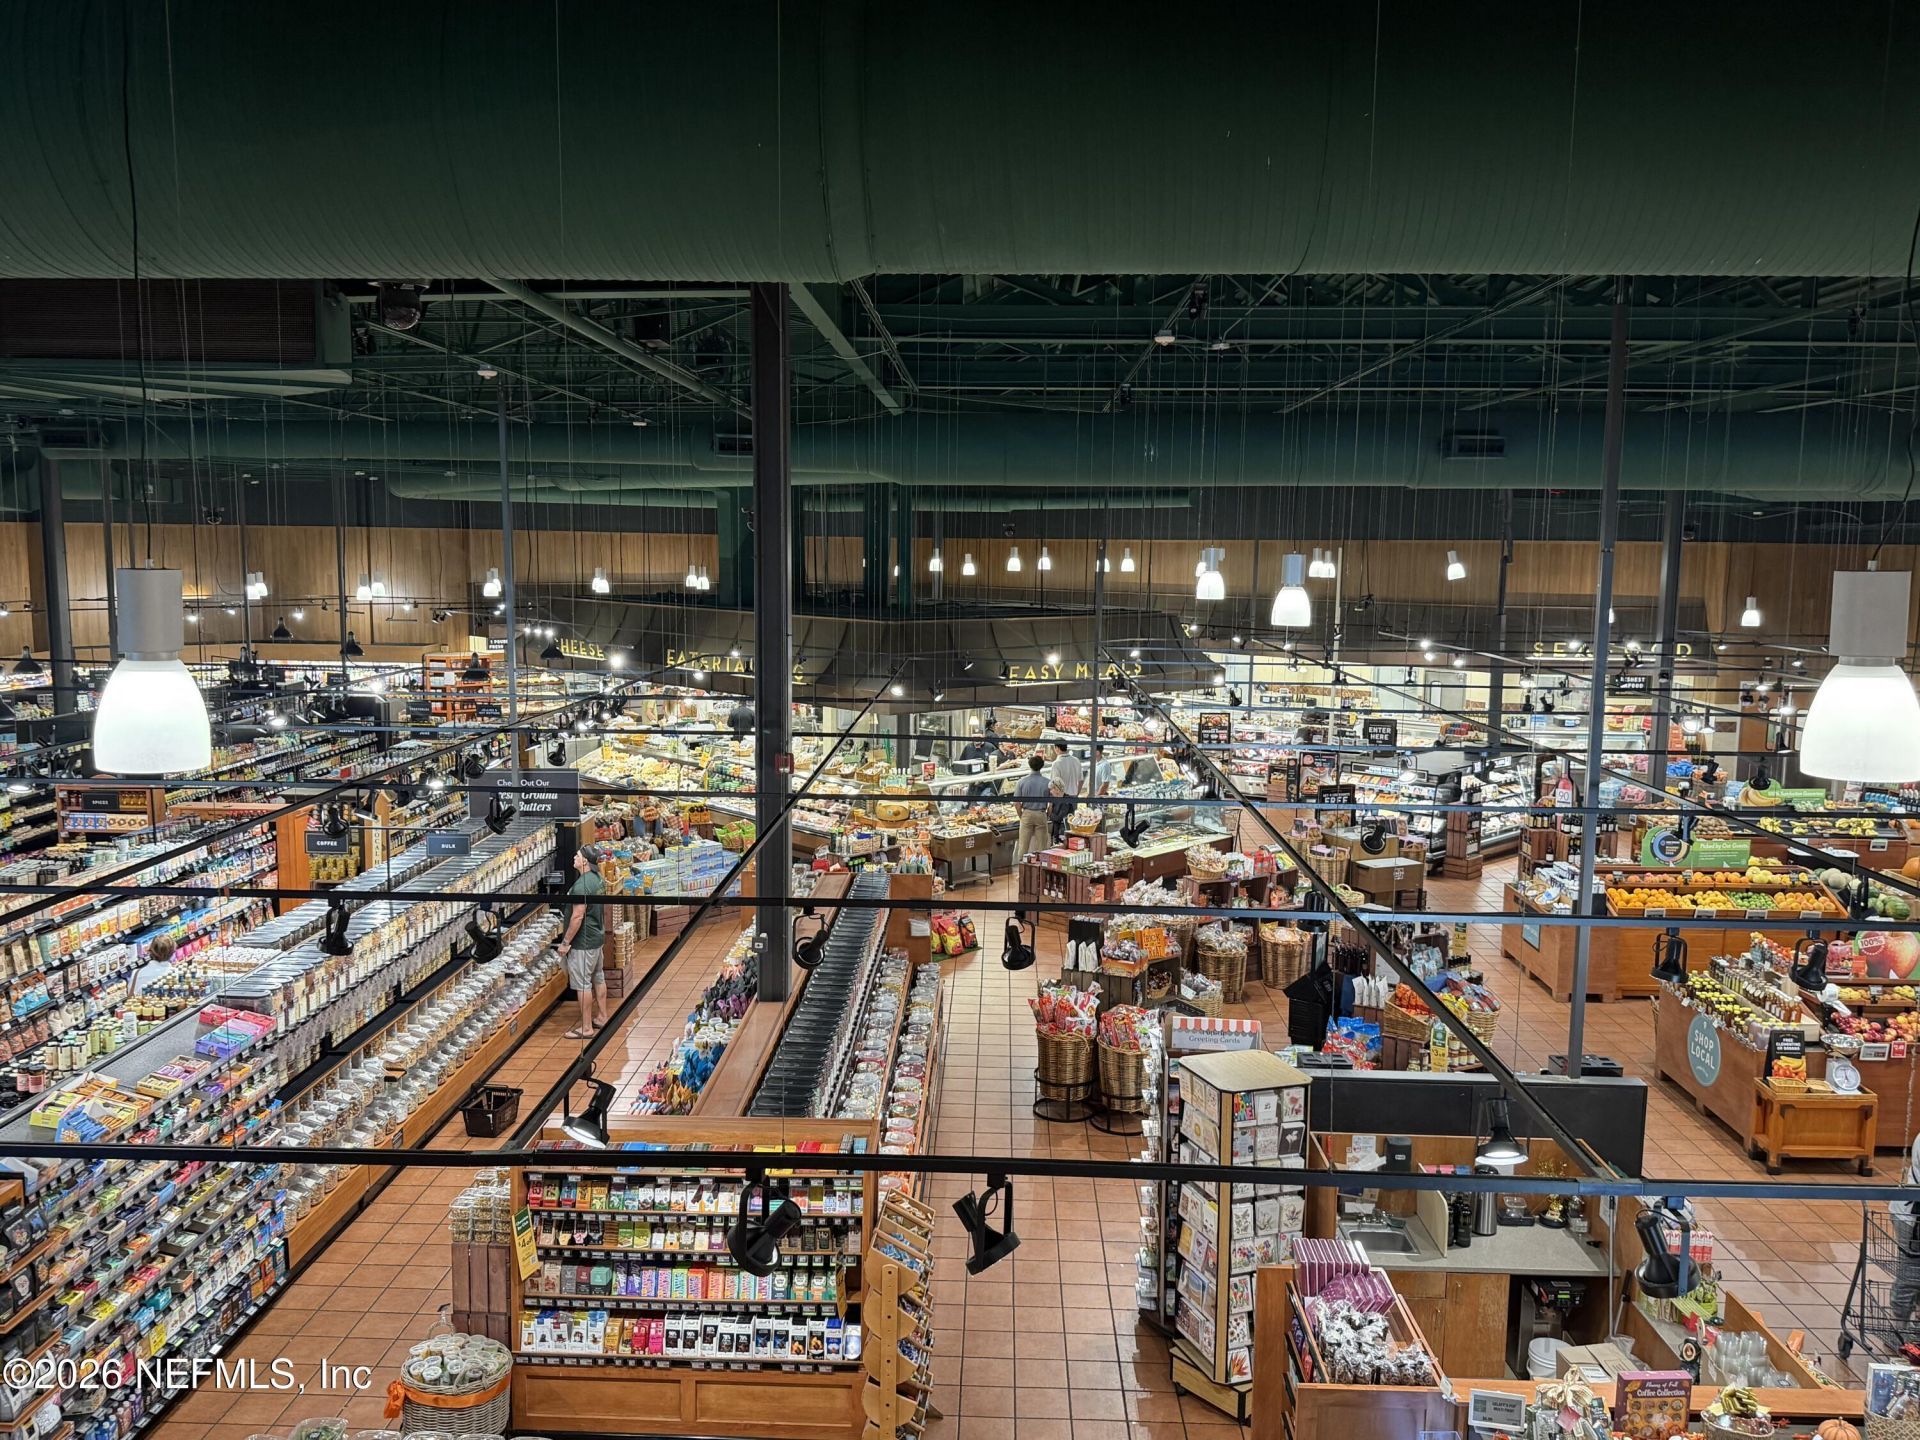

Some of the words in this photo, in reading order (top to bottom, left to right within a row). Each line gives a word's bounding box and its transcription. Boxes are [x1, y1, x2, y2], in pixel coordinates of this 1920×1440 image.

[1009, 664, 1063, 680] EASY
[1076, 661, 1142, 680] MALS
[1368, 726, 1392, 734] ENTER
[1860, 936, 1883, 947] 100%
[1188, 1035, 1220, 1044] Greeting
[1694, 1029, 1714, 1052] SHOP
[1691, 1041, 1715, 1070] LOCAL
